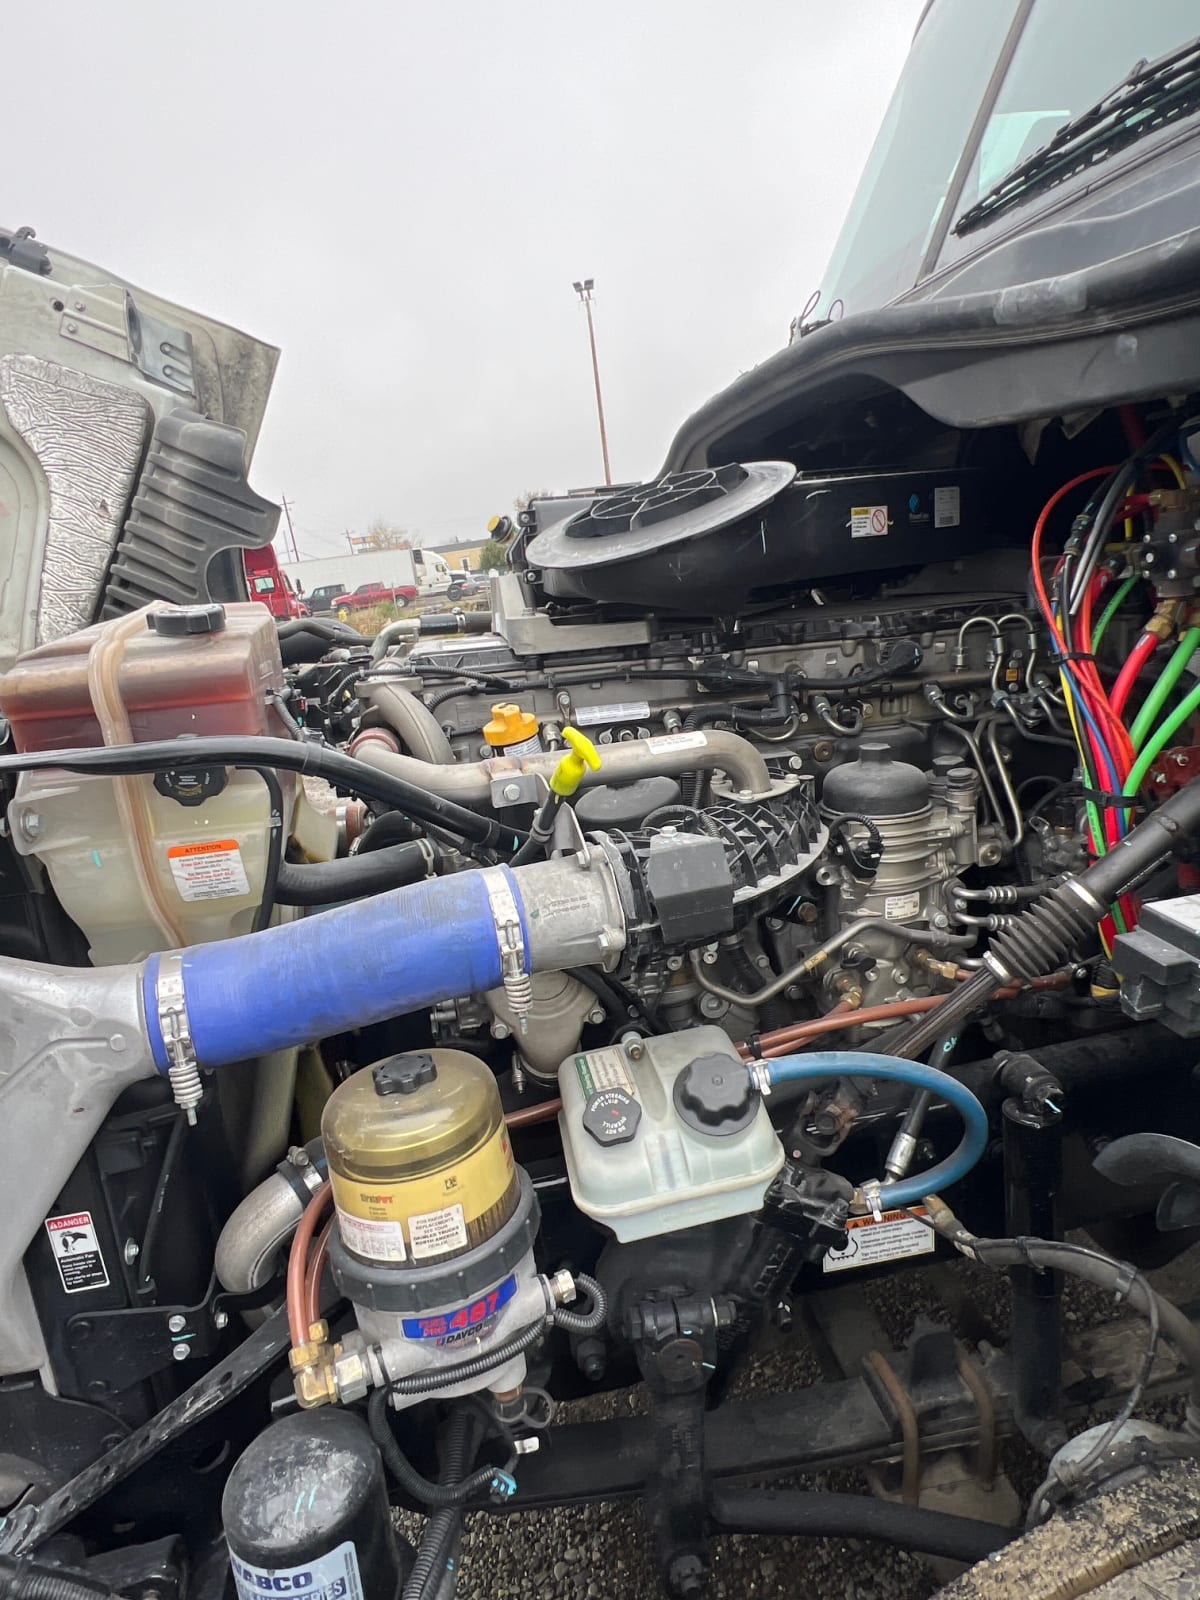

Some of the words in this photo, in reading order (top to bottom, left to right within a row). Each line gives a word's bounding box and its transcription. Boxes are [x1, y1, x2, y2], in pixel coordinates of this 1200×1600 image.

[184, 844, 222, 854] ATTENTION
[591, 1096, 604, 1112] POWER
[605, 1092, 630, 1105] STEERING
[600, 1098, 618, 1108] FLUID
[56, 1216, 90, 1228] DANGER
[418, 1317, 448, 1329] FUEL
[423, 1325, 447, 1336] PRO
[446, 1323, 483, 1344] DAVCO
